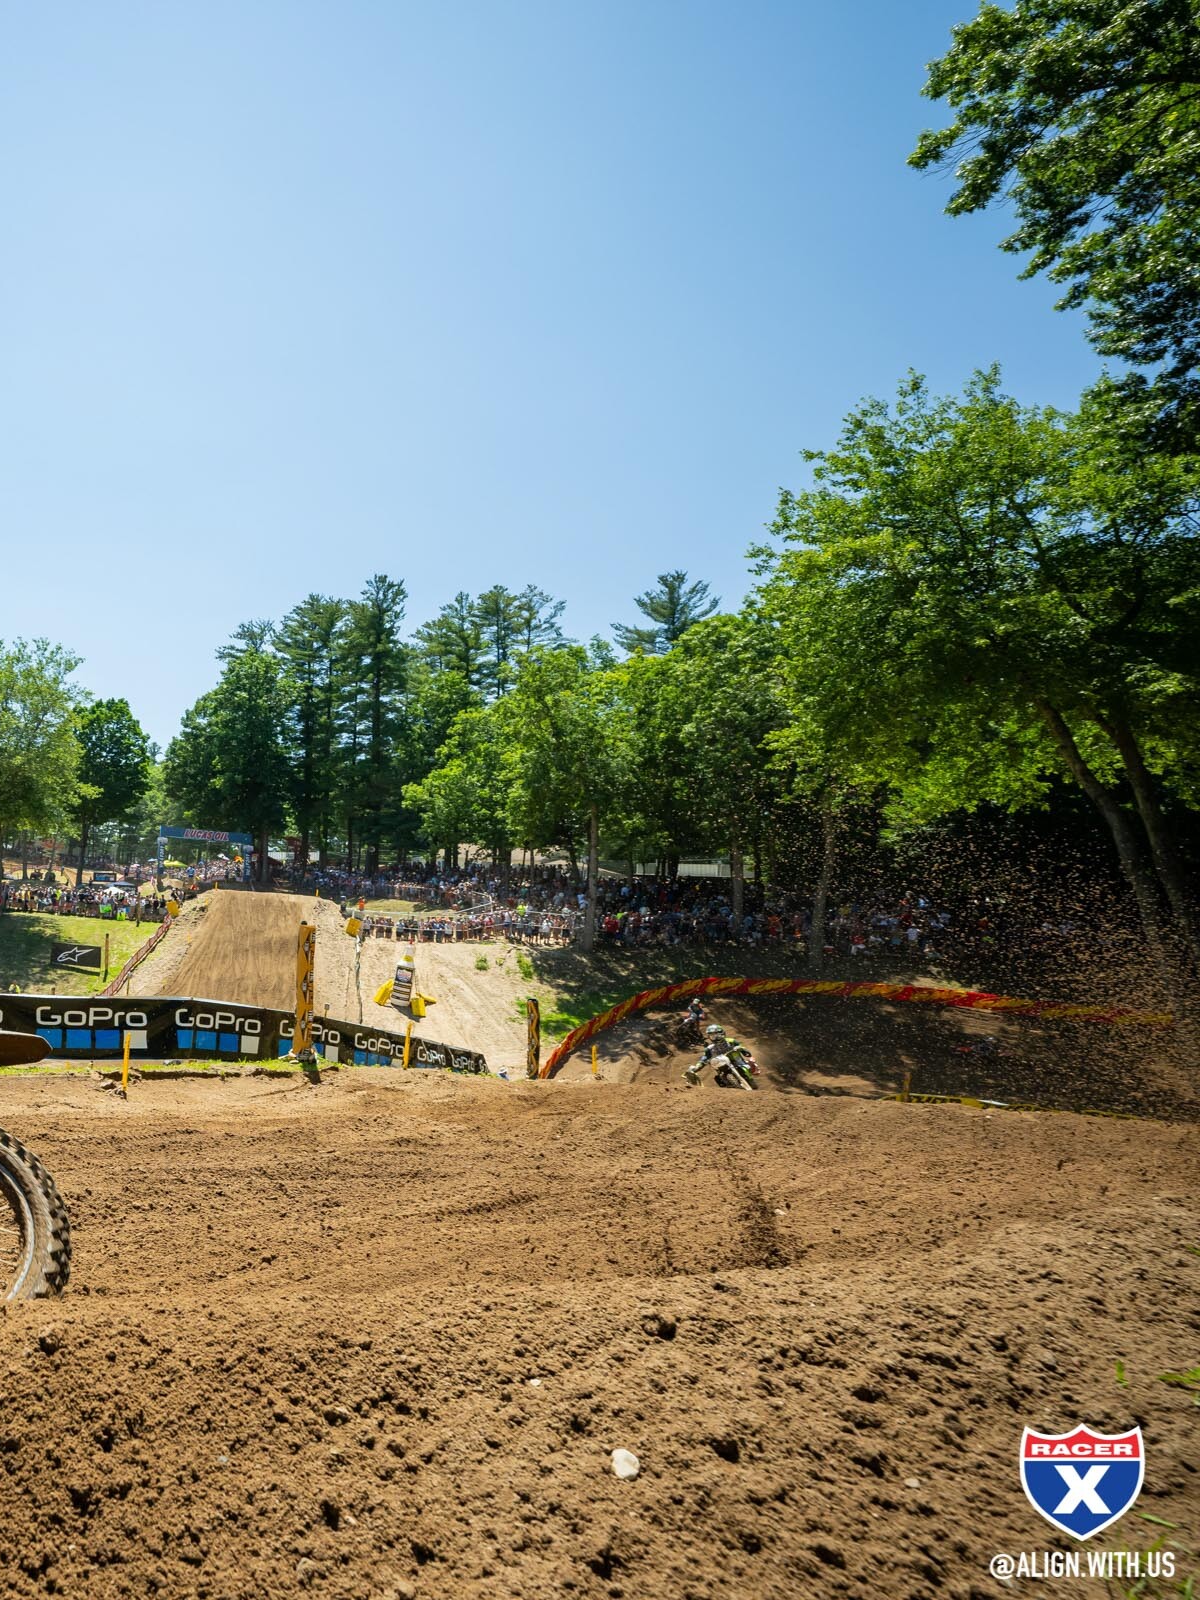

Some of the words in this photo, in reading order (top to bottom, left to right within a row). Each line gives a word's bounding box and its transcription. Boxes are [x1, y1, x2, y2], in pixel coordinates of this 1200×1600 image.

[184, 829, 213, 841] LUCAS
[214, 832, 229, 842] OIL
[36, 1006, 148, 1027] GoPro
[175, 1008, 261, 1034] GoPro
[279, 1020, 341, 1044] GPro
[355, 1033, 405, 1057] GoPro
